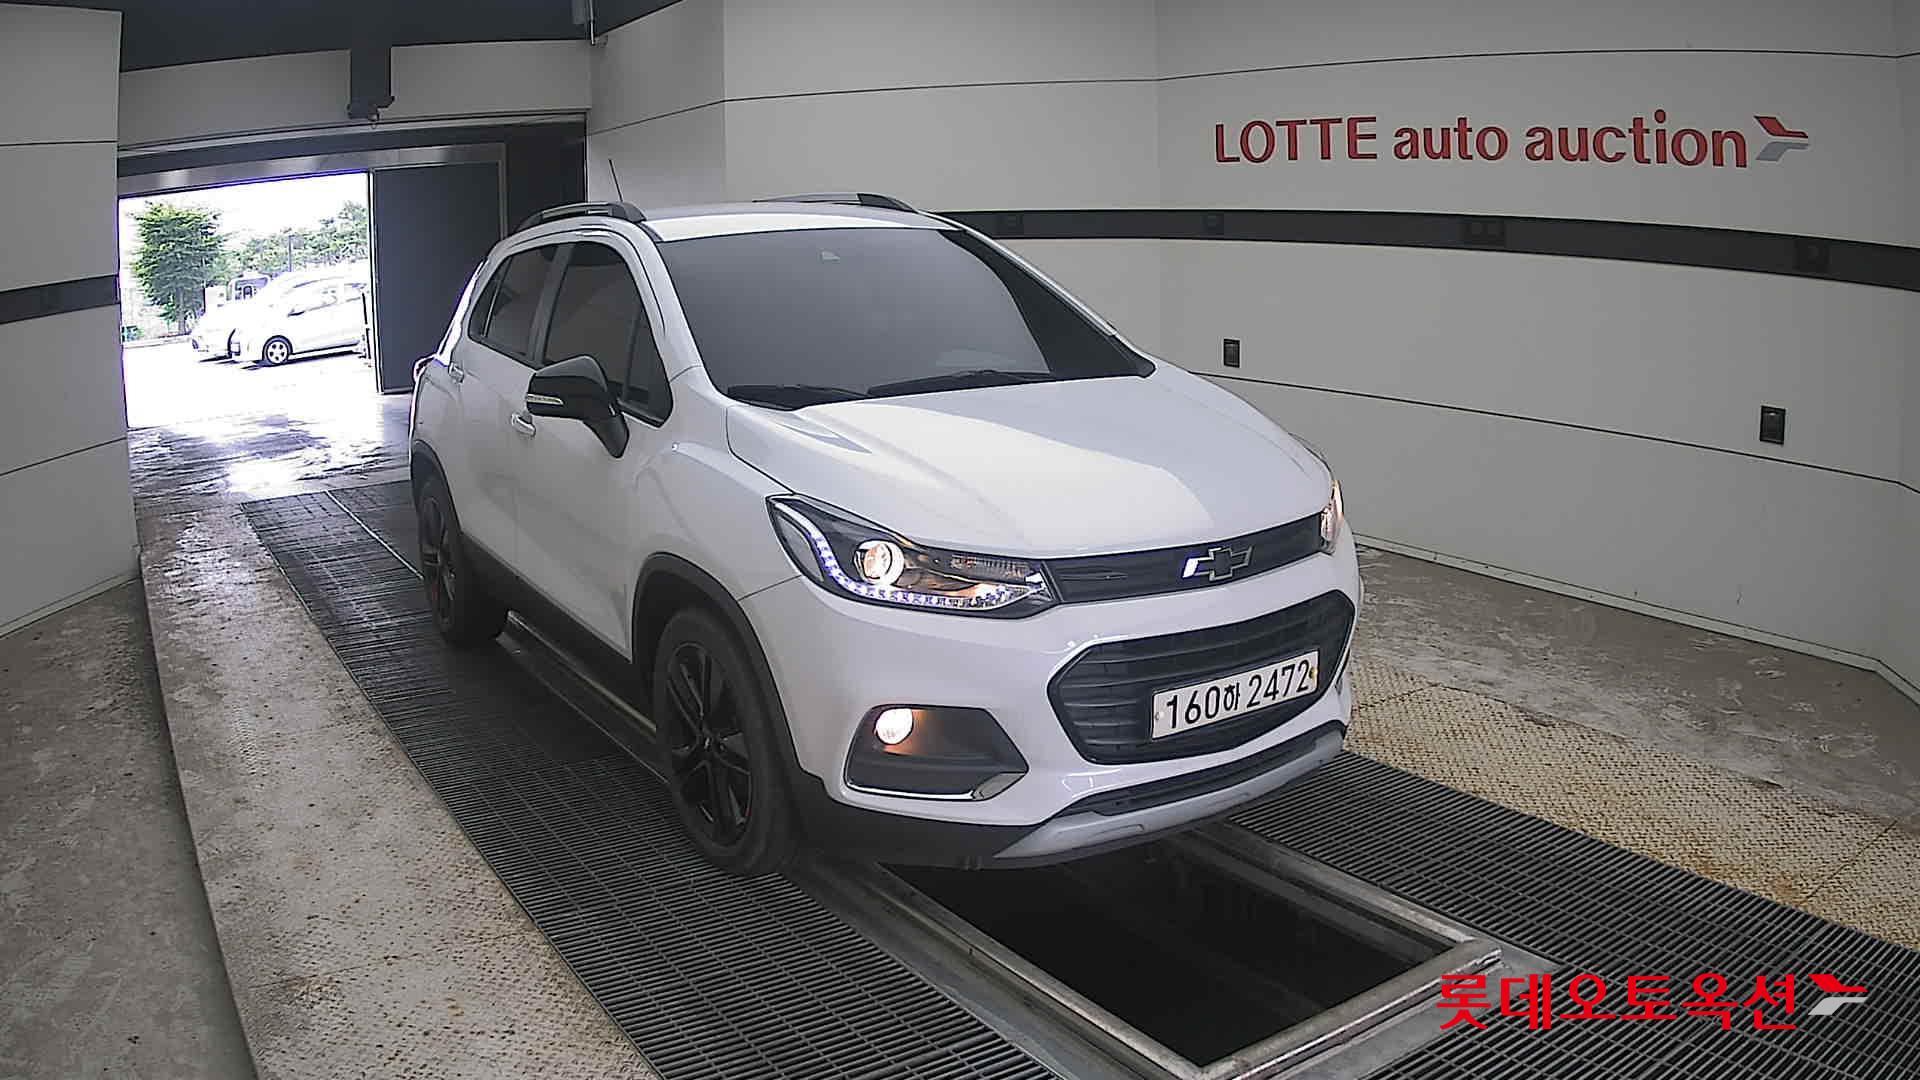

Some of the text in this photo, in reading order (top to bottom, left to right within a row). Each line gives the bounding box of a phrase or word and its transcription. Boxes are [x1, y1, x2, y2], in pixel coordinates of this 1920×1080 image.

[1215, 110, 1747, 168] LOTTE auto auction
